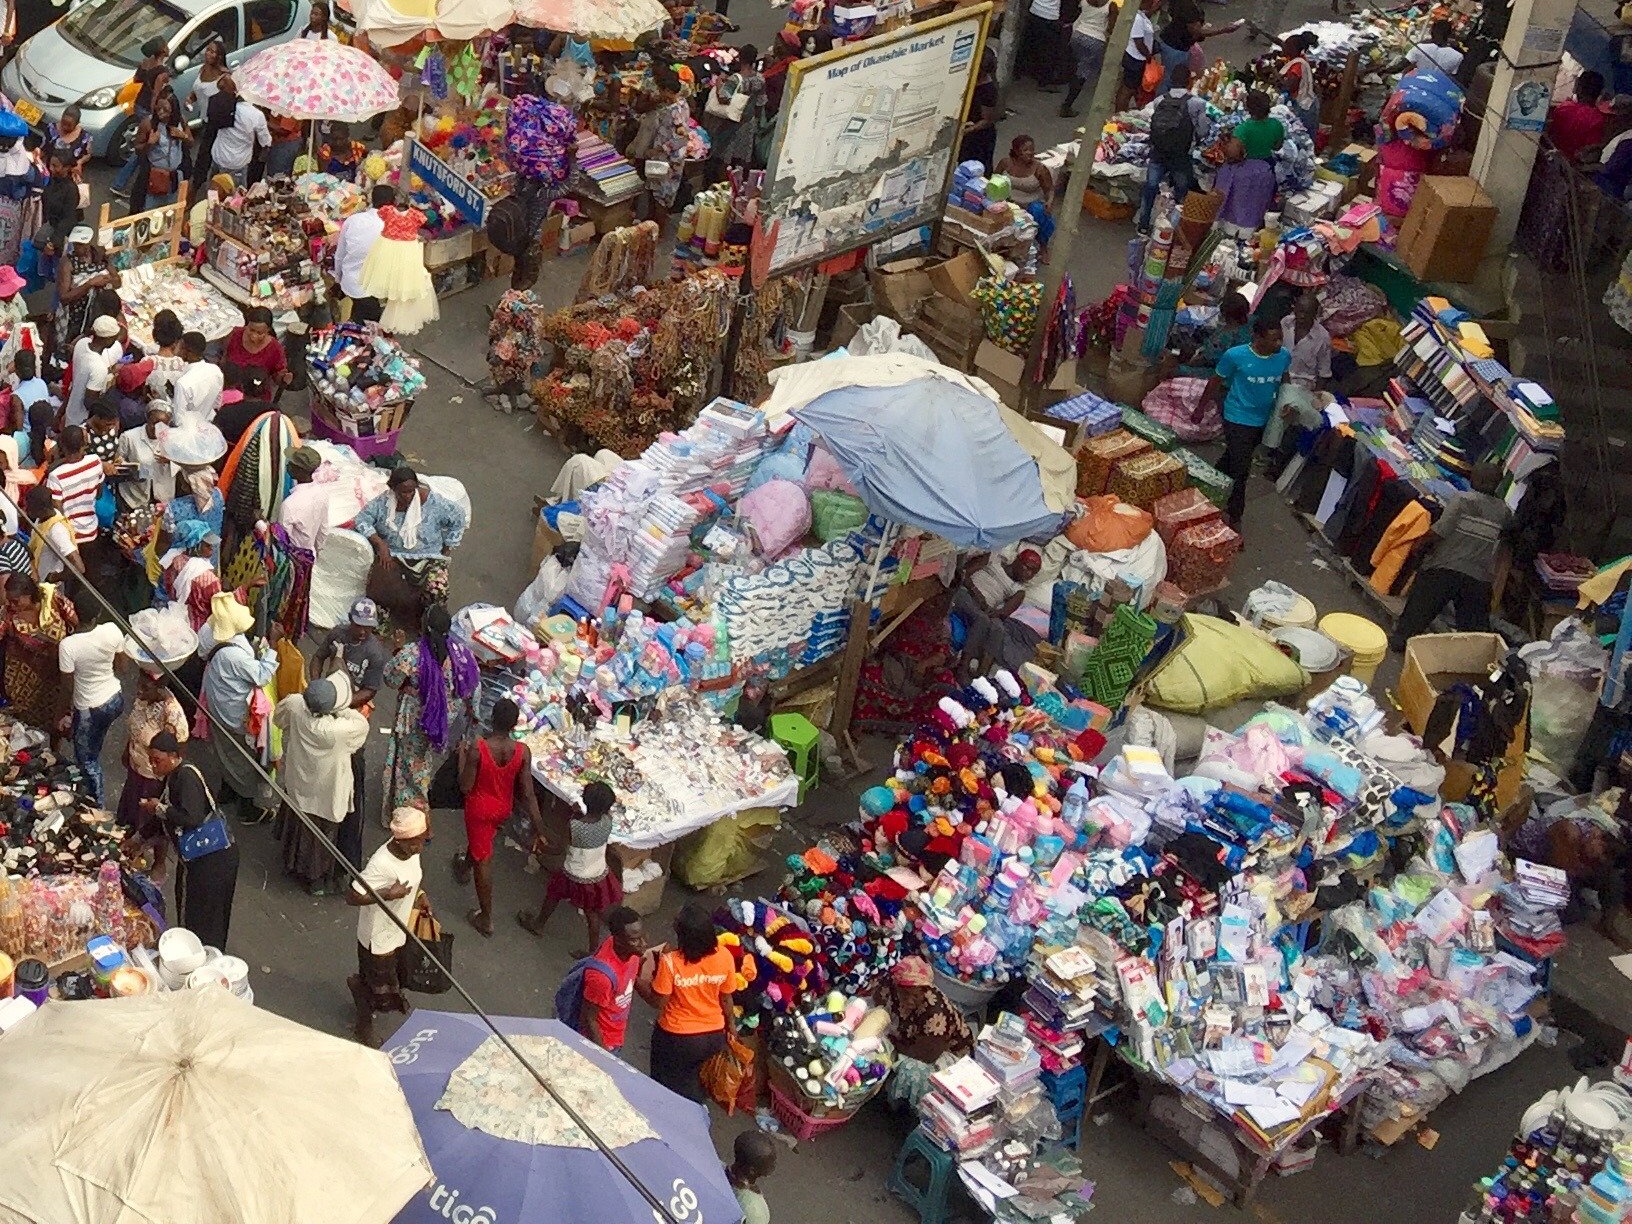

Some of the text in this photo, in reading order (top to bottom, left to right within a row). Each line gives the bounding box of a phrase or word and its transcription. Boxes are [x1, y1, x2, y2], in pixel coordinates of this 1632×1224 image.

[827, 66, 848, 81] Map
[850, 59, 862, 74] of
[909, 34, 946, 57] Market
[413, 144, 480, 212] KNUTSFORD ST.
[673, 973, 699, 989] Good
[387, 1028, 438, 1066] tigo
[428, 1183, 498, 1224] tigo
